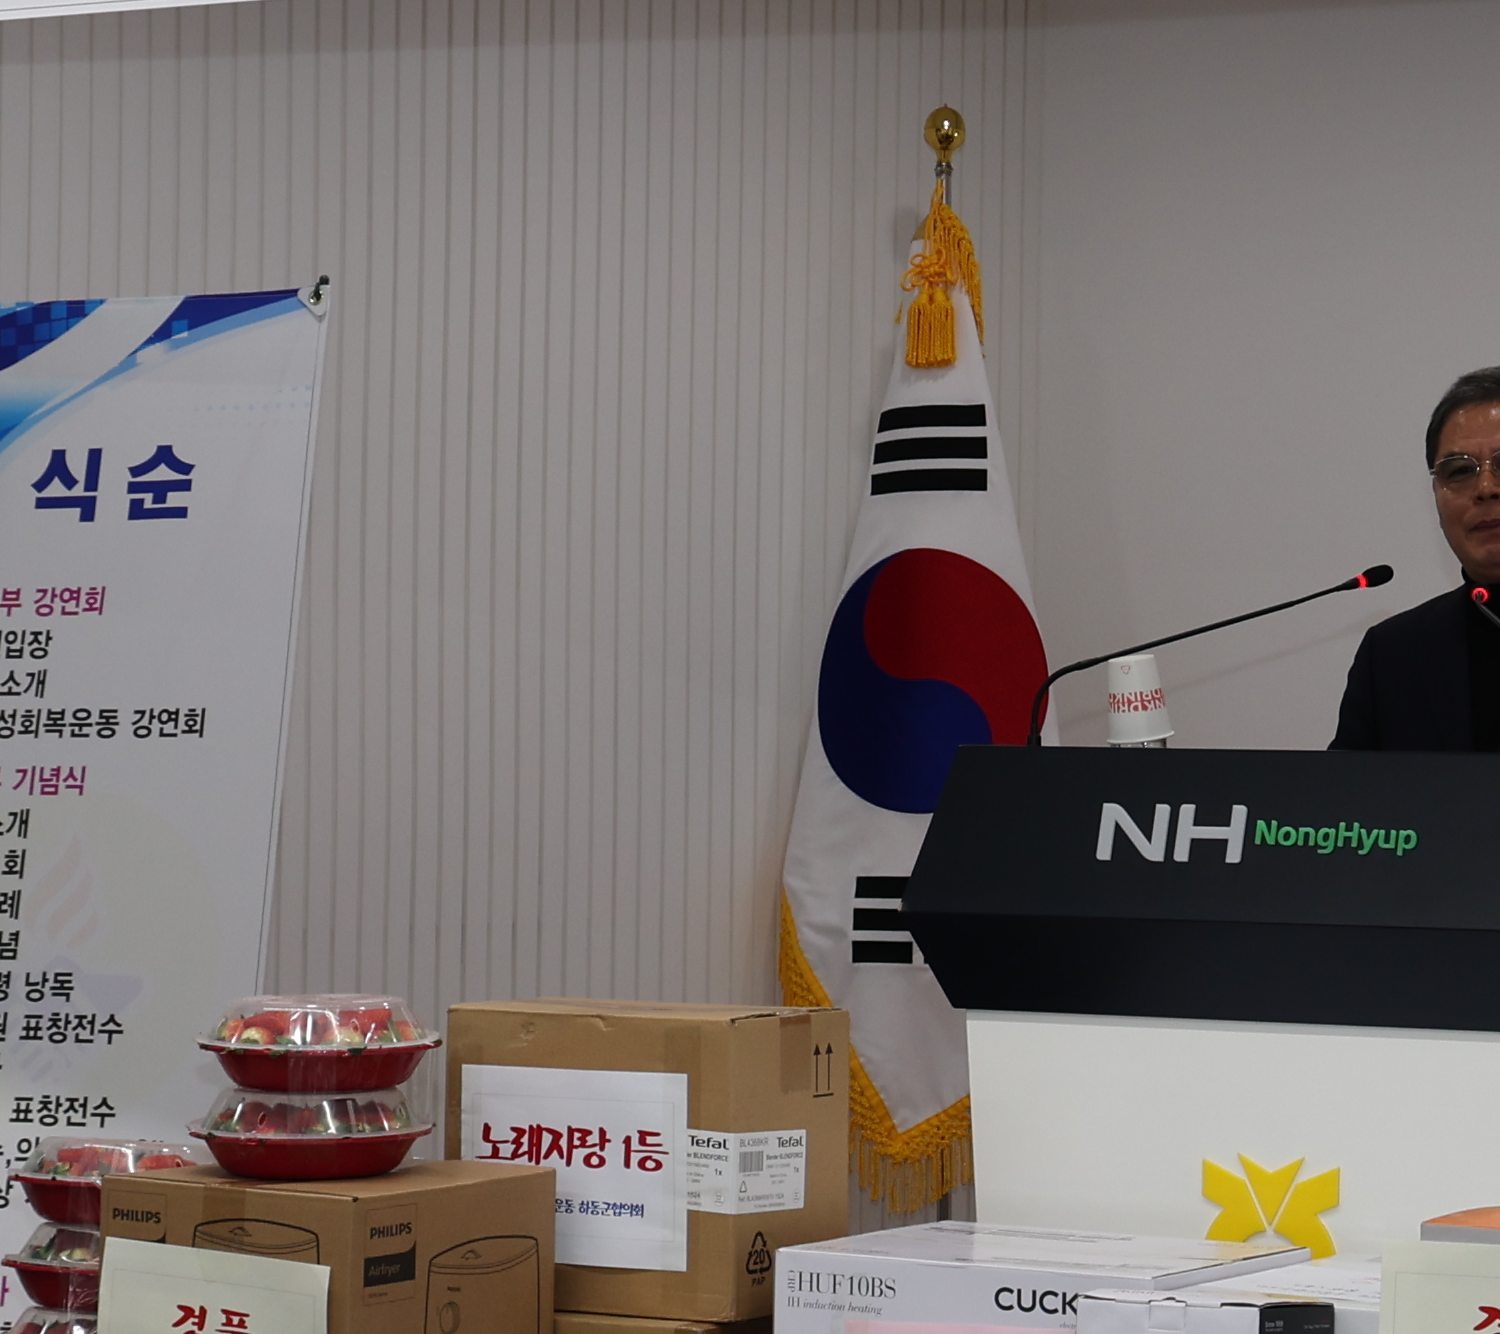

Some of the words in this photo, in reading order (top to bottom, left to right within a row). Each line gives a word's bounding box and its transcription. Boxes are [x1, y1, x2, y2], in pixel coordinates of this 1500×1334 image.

[33, 586, 107, 616] 강연회
[131, 707, 207, 738] 강연회
[13, 765, 87, 796] 기념식
[1095, 803, 1248, 864] NH
[1254, 819, 1418, 856] NongHyup
[24, 971, 76, 1004] 낭독
[19, 1012, 124, 1045] 표창전수
[9, 1095, 116, 1128] 표창전수
[476, 1123, 610, 1168] 노래자랑
[622, 1130, 669, 1171] 1등
[690, 1135, 729, 1150] Tefal
[776, 1136, 803, 1148] Tefal
[112, 1207, 161, 1224] PHILIPS
[578, 1201, 644, 1218] 하동군협의회
[370, 1222, 412, 1240] PHILIPS
[368, 1261, 401, 1278] Airfryer
[798, 1271, 897, 1299] HUF10BS
[803, 1298, 846, 1313] induction
[848, 1303, 882, 1315] heating
